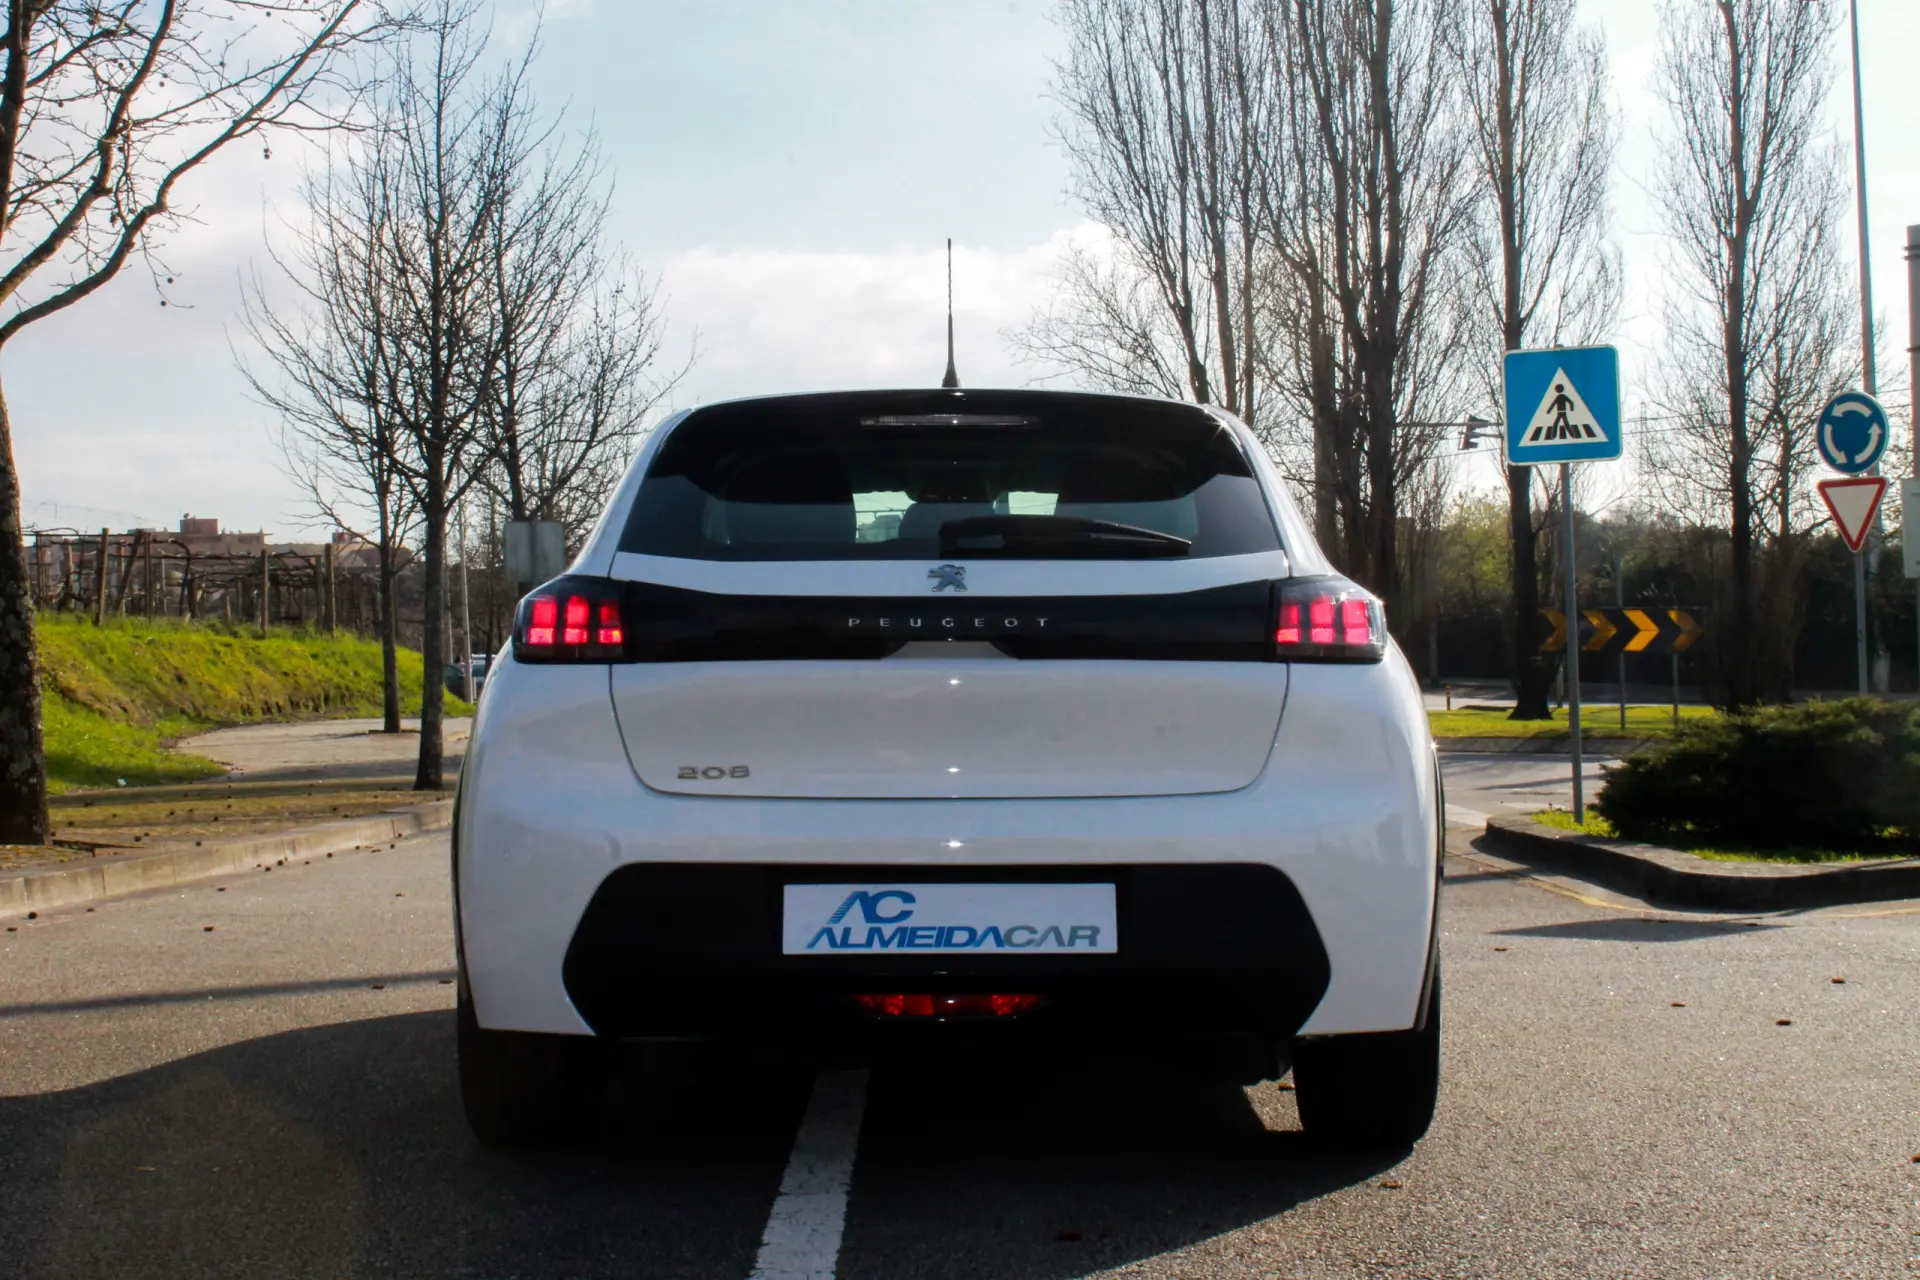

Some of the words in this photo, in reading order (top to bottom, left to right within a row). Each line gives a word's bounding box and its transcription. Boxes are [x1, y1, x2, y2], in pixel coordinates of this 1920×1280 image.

[849, 618, 1048, 628] PEUGEOT
[677, 765, 750, 780] 208
[826, 890, 916, 924] AC
